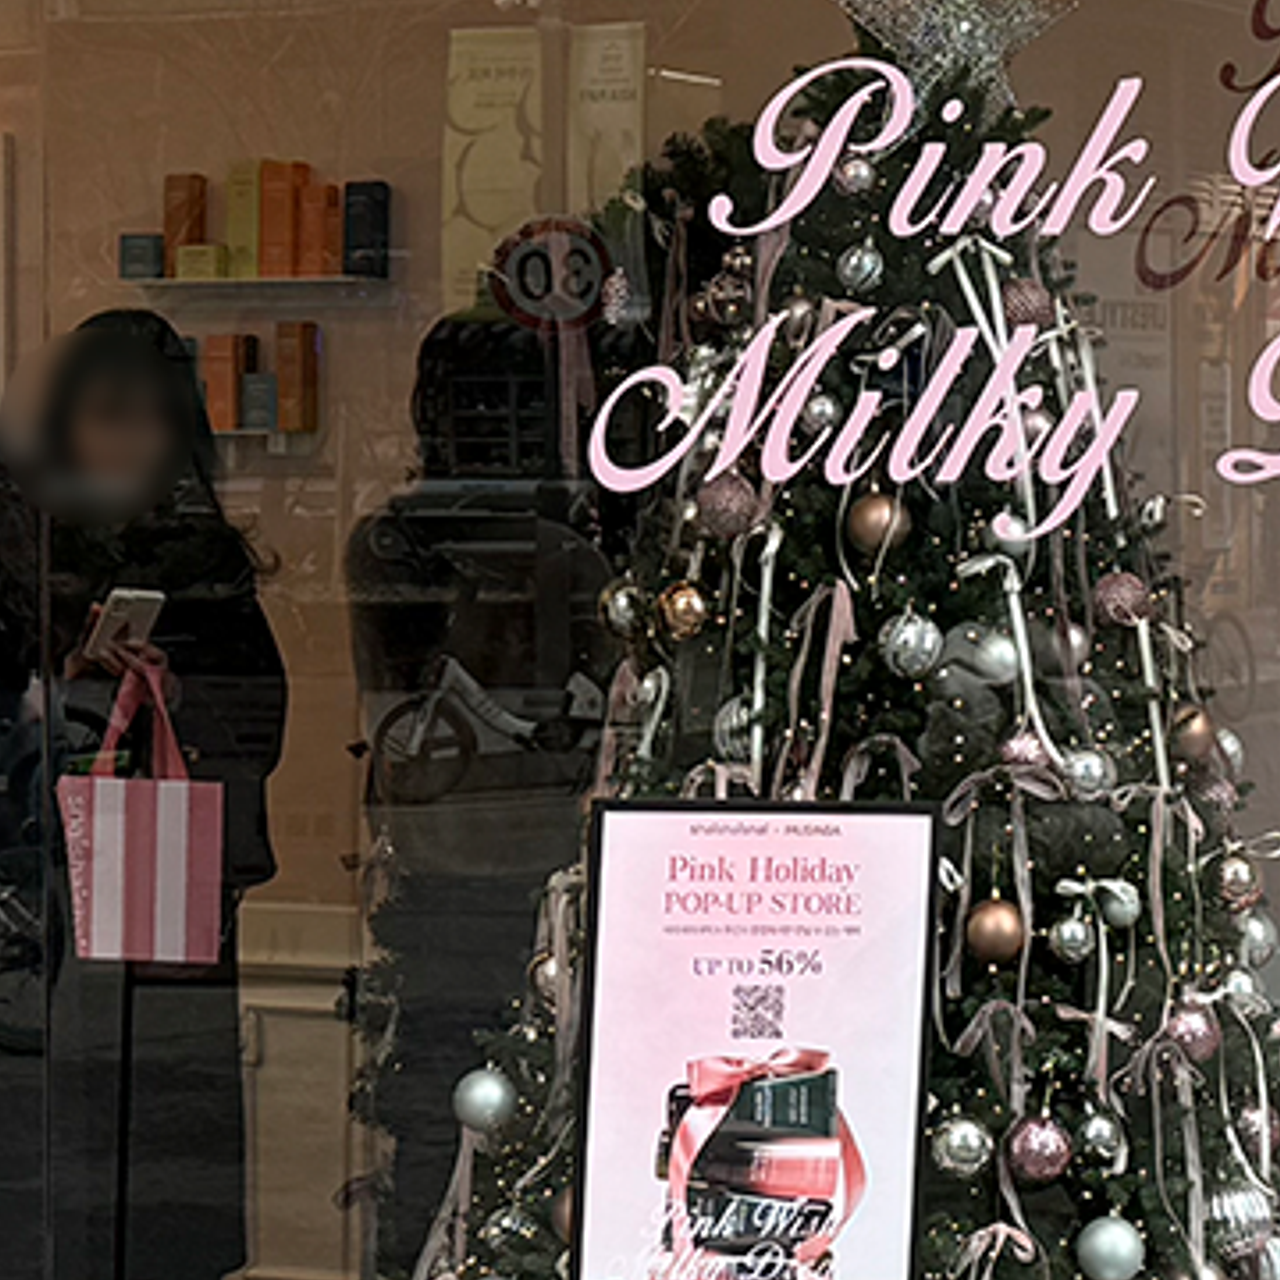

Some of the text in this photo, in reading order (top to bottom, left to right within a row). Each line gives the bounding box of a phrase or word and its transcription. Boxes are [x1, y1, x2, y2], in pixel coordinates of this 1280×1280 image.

[707, 56, 1157, 236] Pink
[587, 305, 1140, 541] Milky
[668, 855, 862, 892] Pink Holiday
[664, 891, 863, 916] POP-UP STORE
[727, 957, 754, 975] TO
[758, 949, 824, 976] 56%
